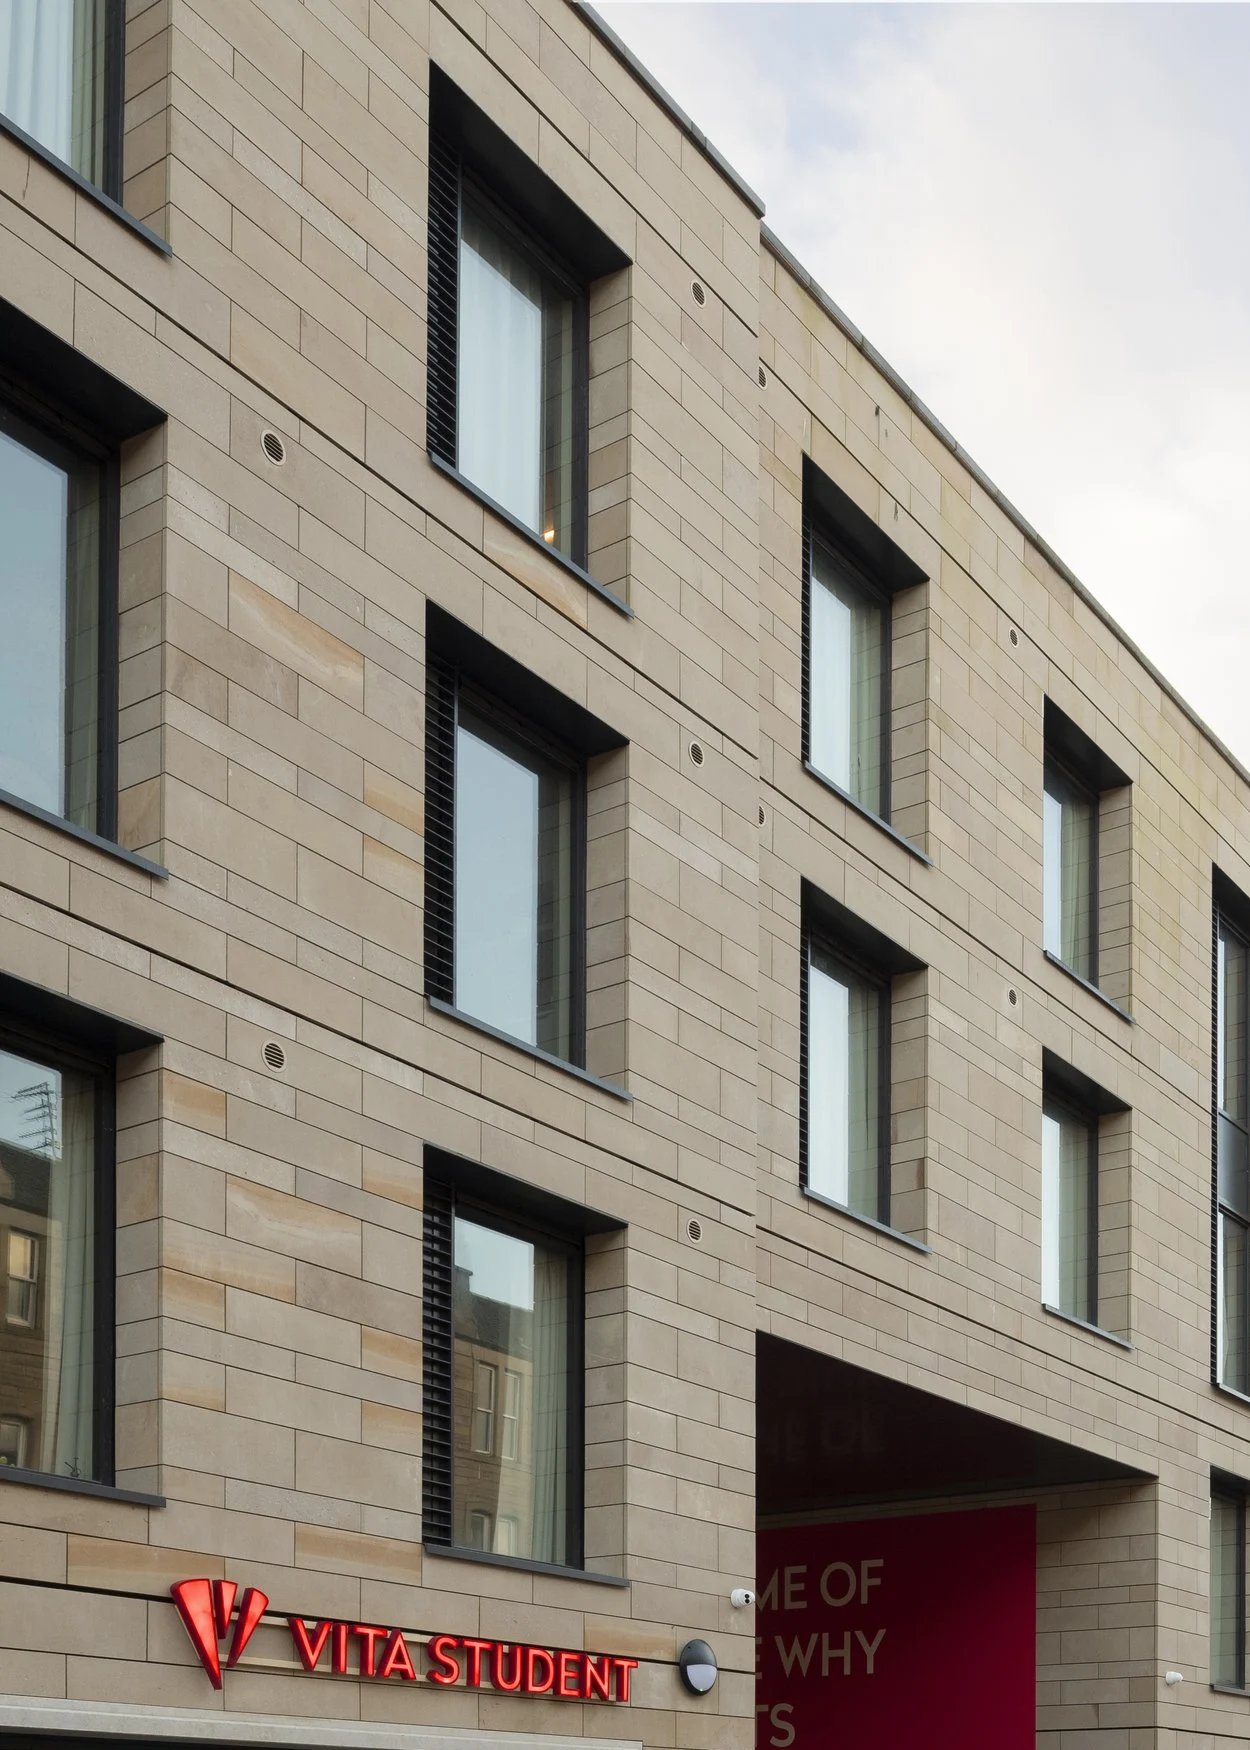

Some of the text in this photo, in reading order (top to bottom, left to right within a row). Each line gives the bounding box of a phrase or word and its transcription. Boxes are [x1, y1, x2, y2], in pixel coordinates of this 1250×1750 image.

[820, 1559, 884, 1607] OF
[286, 1617, 639, 1703] VITA STUDENT
[774, 1628, 887, 1679] WHY
